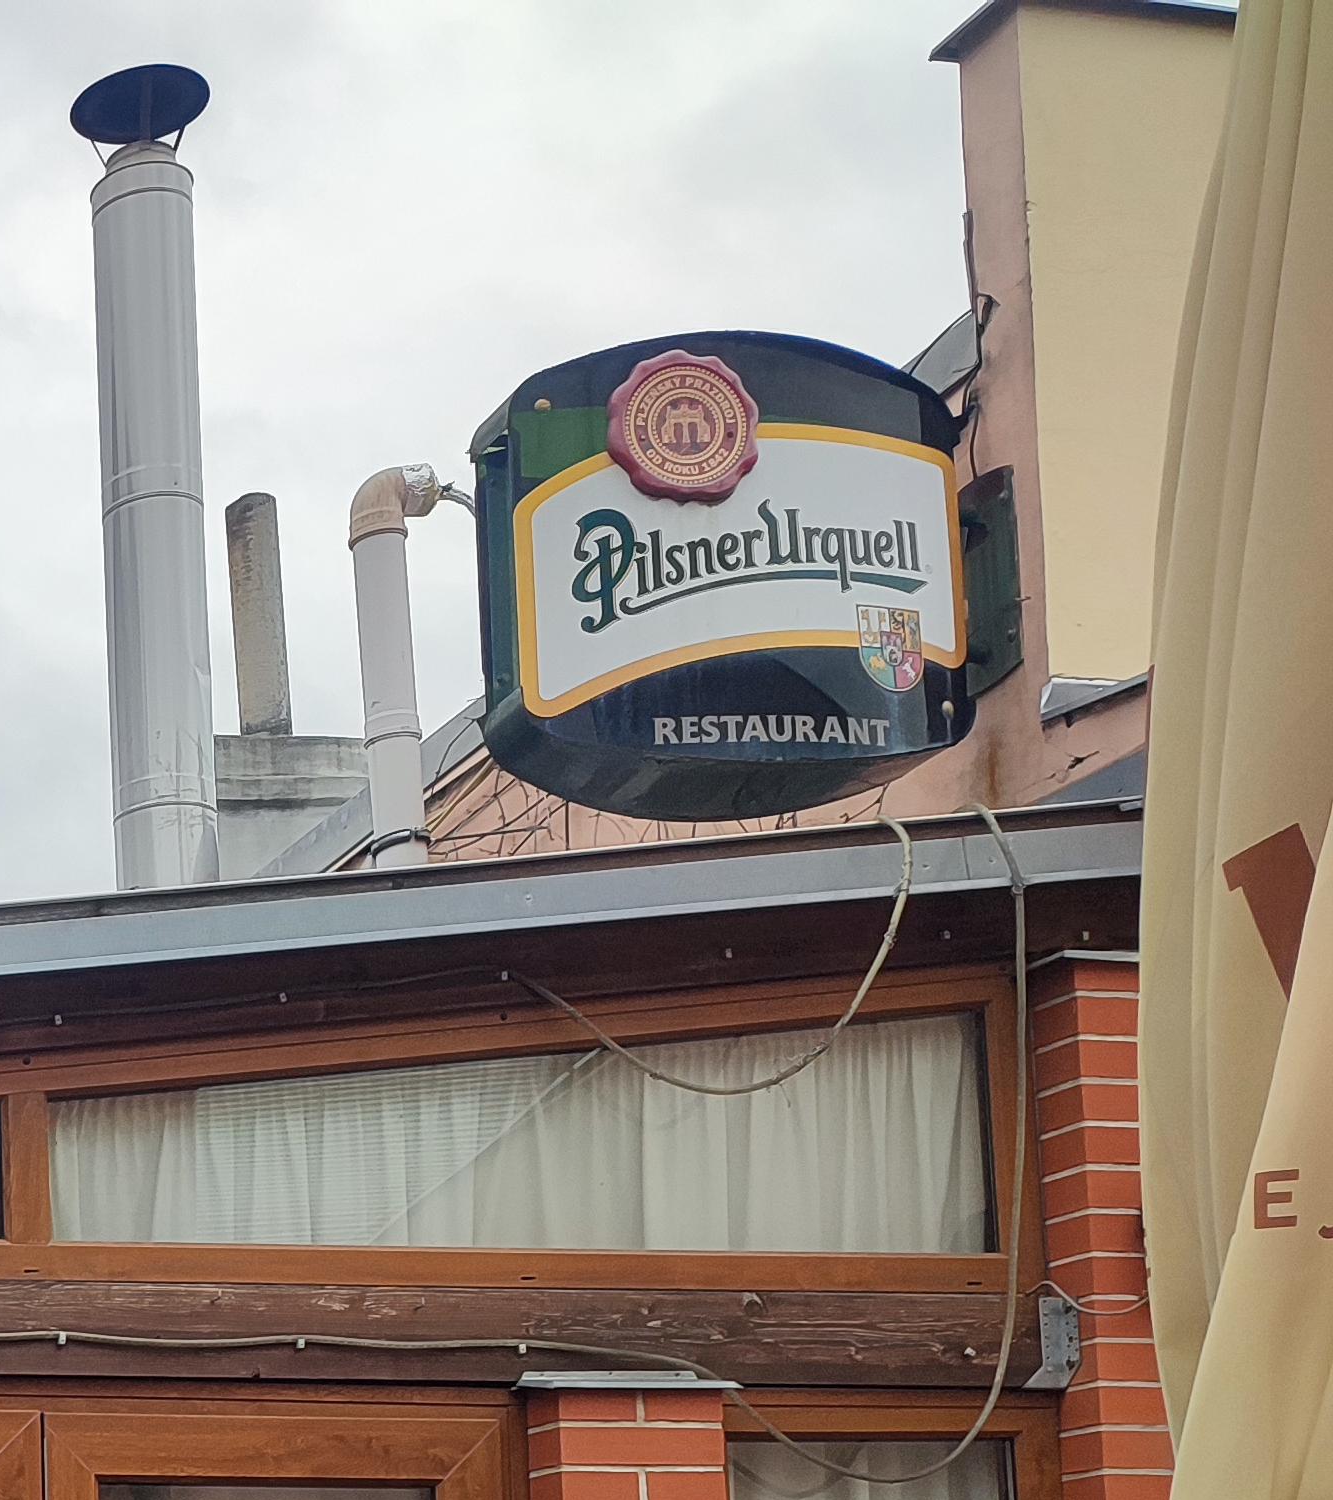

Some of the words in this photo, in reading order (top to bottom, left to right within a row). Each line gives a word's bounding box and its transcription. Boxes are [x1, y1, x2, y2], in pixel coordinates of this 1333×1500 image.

[646, 449, 663, 465] OD
[664, 463, 700, 474] ROKU
[701, 448, 729, 472] 1842
[571, 509, 763, 634] Pilsner
[758, 499, 923, 593] Urquell
[652, 715, 891, 748] RESTAURANT
